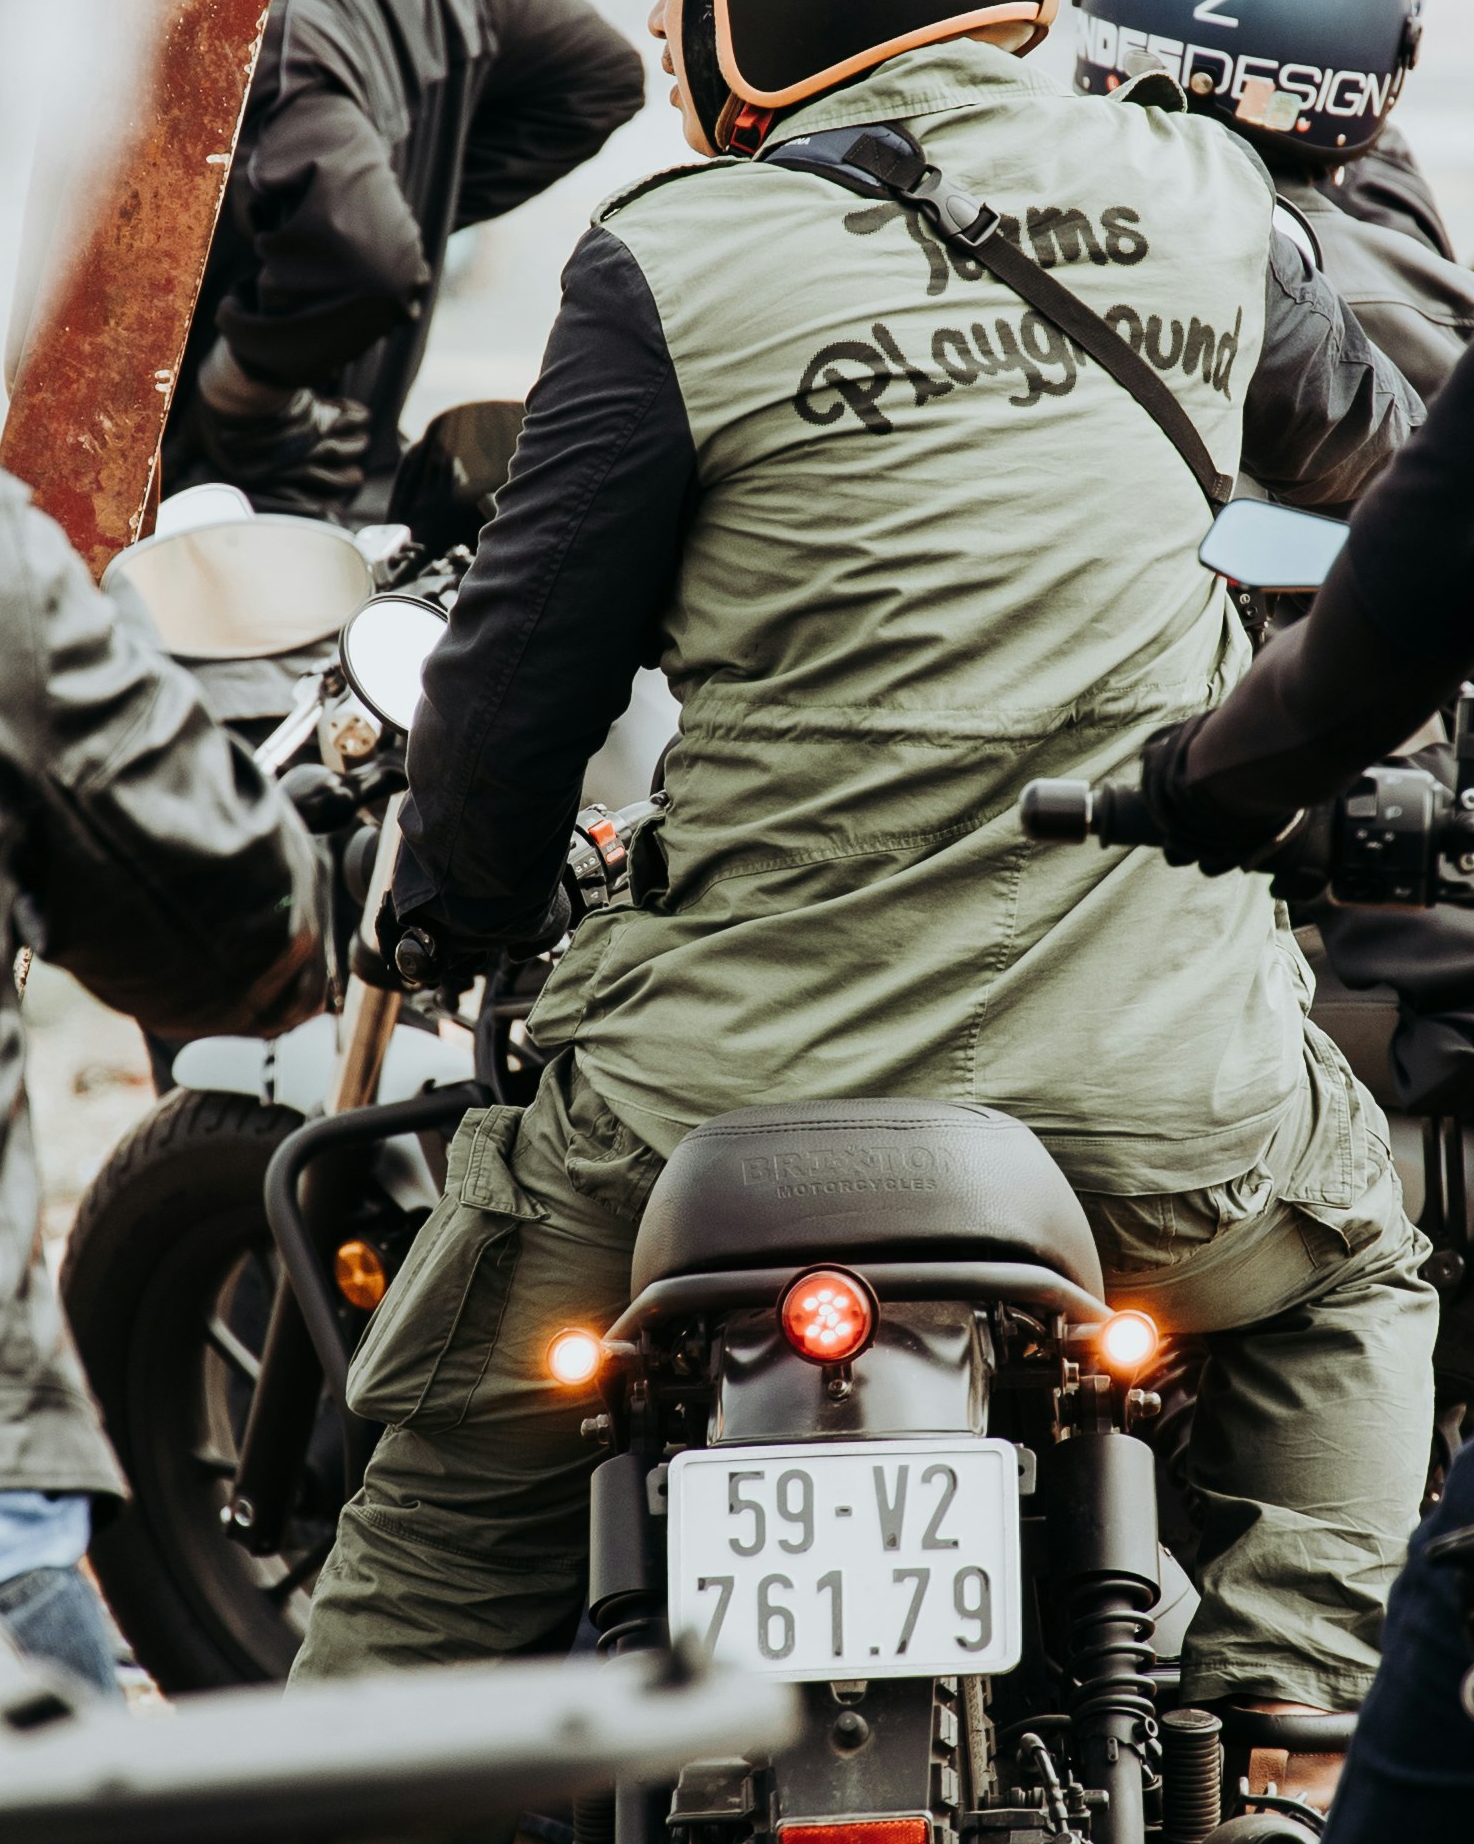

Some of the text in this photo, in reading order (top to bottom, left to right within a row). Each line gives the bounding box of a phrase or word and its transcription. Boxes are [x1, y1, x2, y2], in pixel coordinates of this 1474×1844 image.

[791, 303, 1244, 436] Playgound
[775, 1177, 939, 1200] MOTORCYCLES
[726, 1463, 961, 1558] 59-V2
[695, 1564, 993, 1661] 761.79
